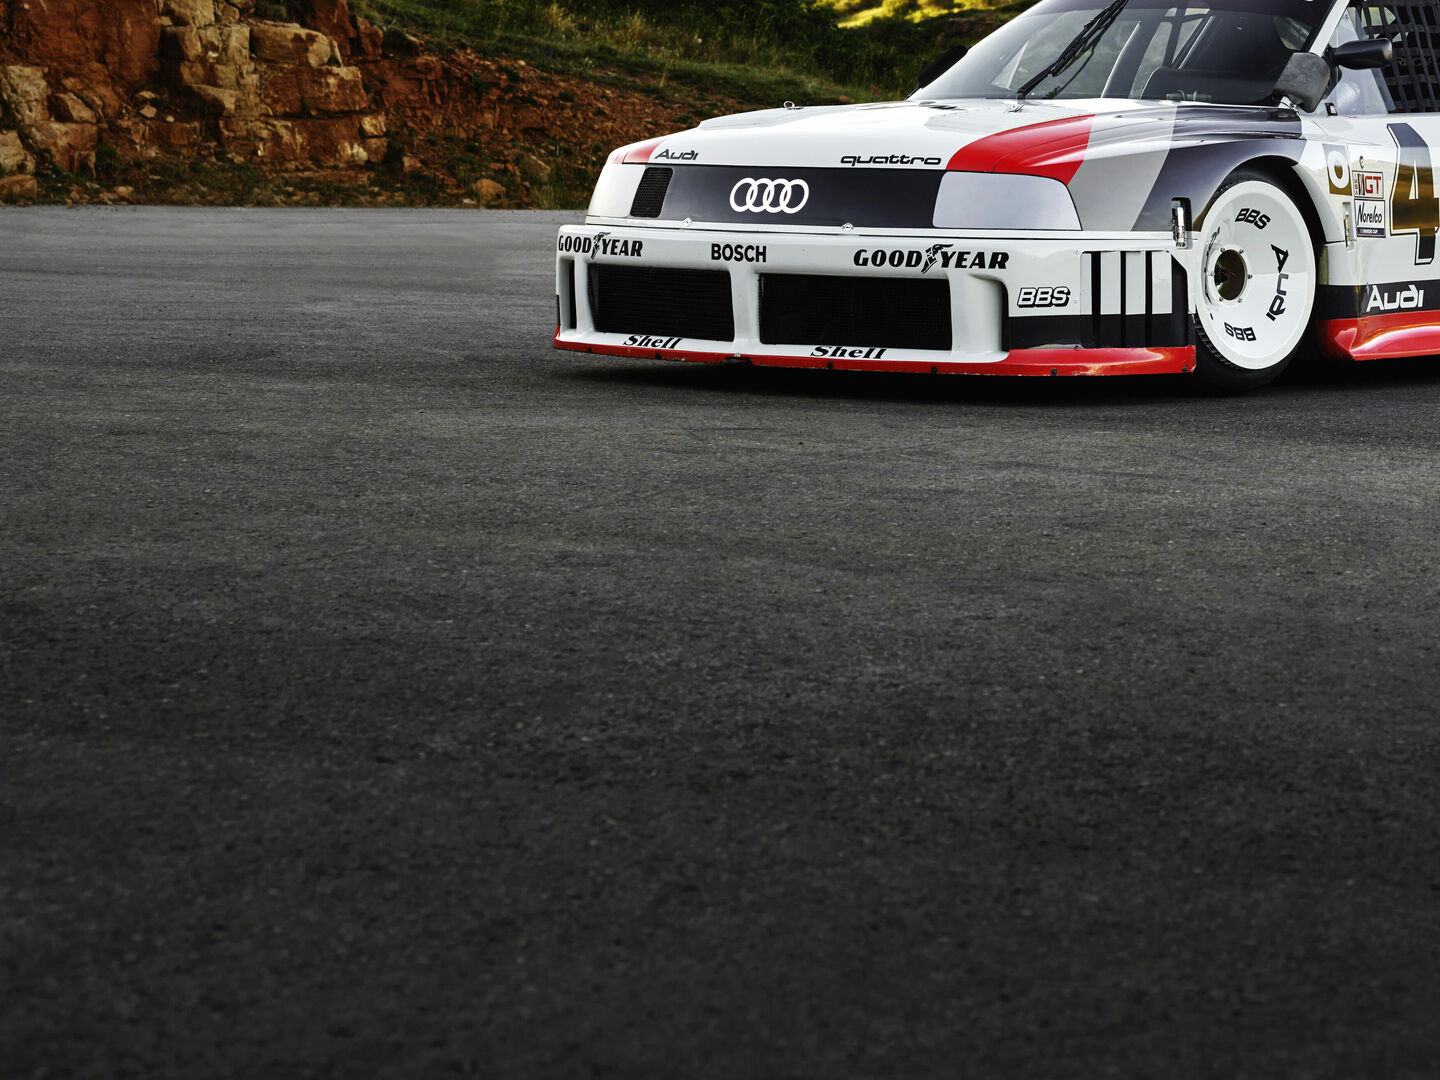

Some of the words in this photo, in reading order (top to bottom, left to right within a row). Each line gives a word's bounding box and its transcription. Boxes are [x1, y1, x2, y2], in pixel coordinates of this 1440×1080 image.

[654, 149, 699, 161] Audi
[840, 154, 942, 167] quattro
[1387, 123, 1440, 266] 4
[1235, 207, 1271, 230] BBS
[1357, 201, 1383, 226] Norelco
[711, 243, 767, 263] BOSCH
[1265, 243, 1290, 322] Audi
[1016, 285, 1072, 308] BBS
[1366, 284, 1425, 312] Audi
[622, 334, 684, 350] Shell
[1223, 321, 1257, 342] BBS
[810, 345, 888, 360] Shell
